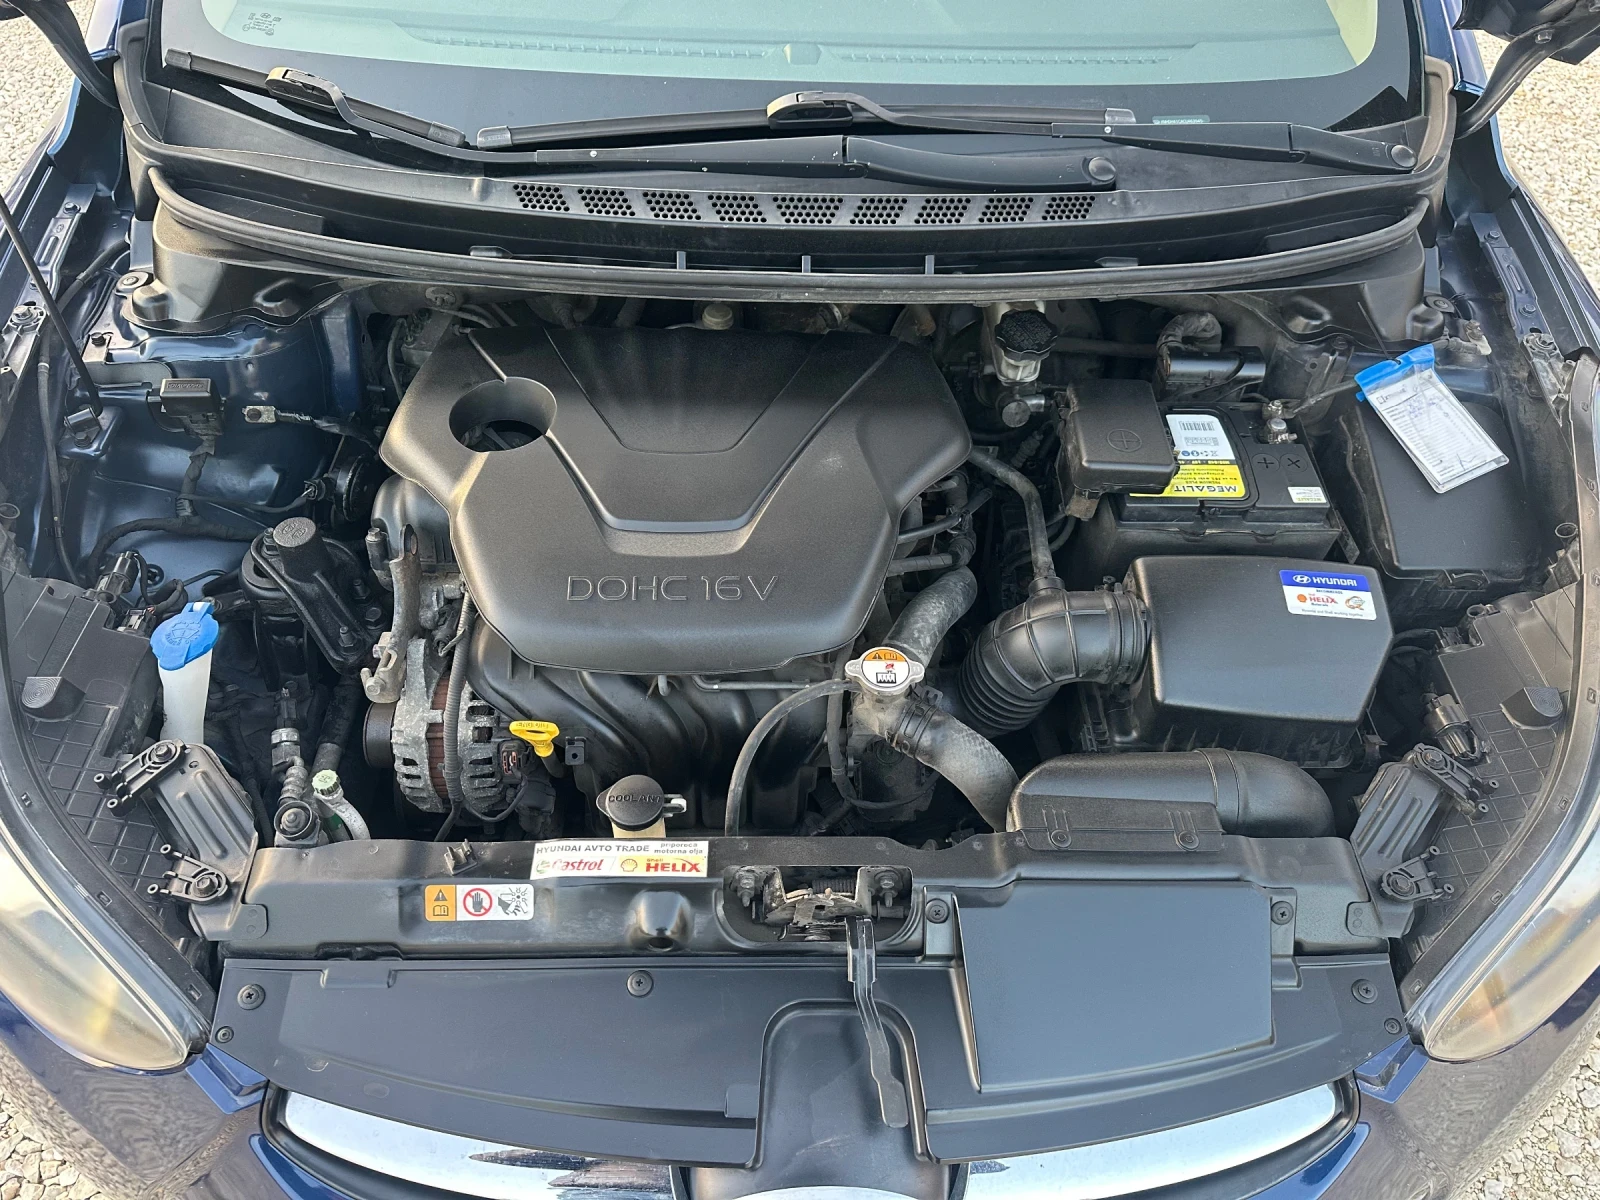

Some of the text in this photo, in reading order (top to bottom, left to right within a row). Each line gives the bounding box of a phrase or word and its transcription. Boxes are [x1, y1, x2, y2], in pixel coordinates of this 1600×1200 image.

[1312, 576, 1358, 587] HYUNDAI
[567, 575, 688, 601] DOHC
[1309, 596, 1338, 604] HELIX
[608, 794, 662, 803] COOLANT
[536, 844, 650, 854] HYUNDAI AVTO TRADE
[552, 859, 605, 871] Castrol
[646, 861, 702, 873] HELIX
